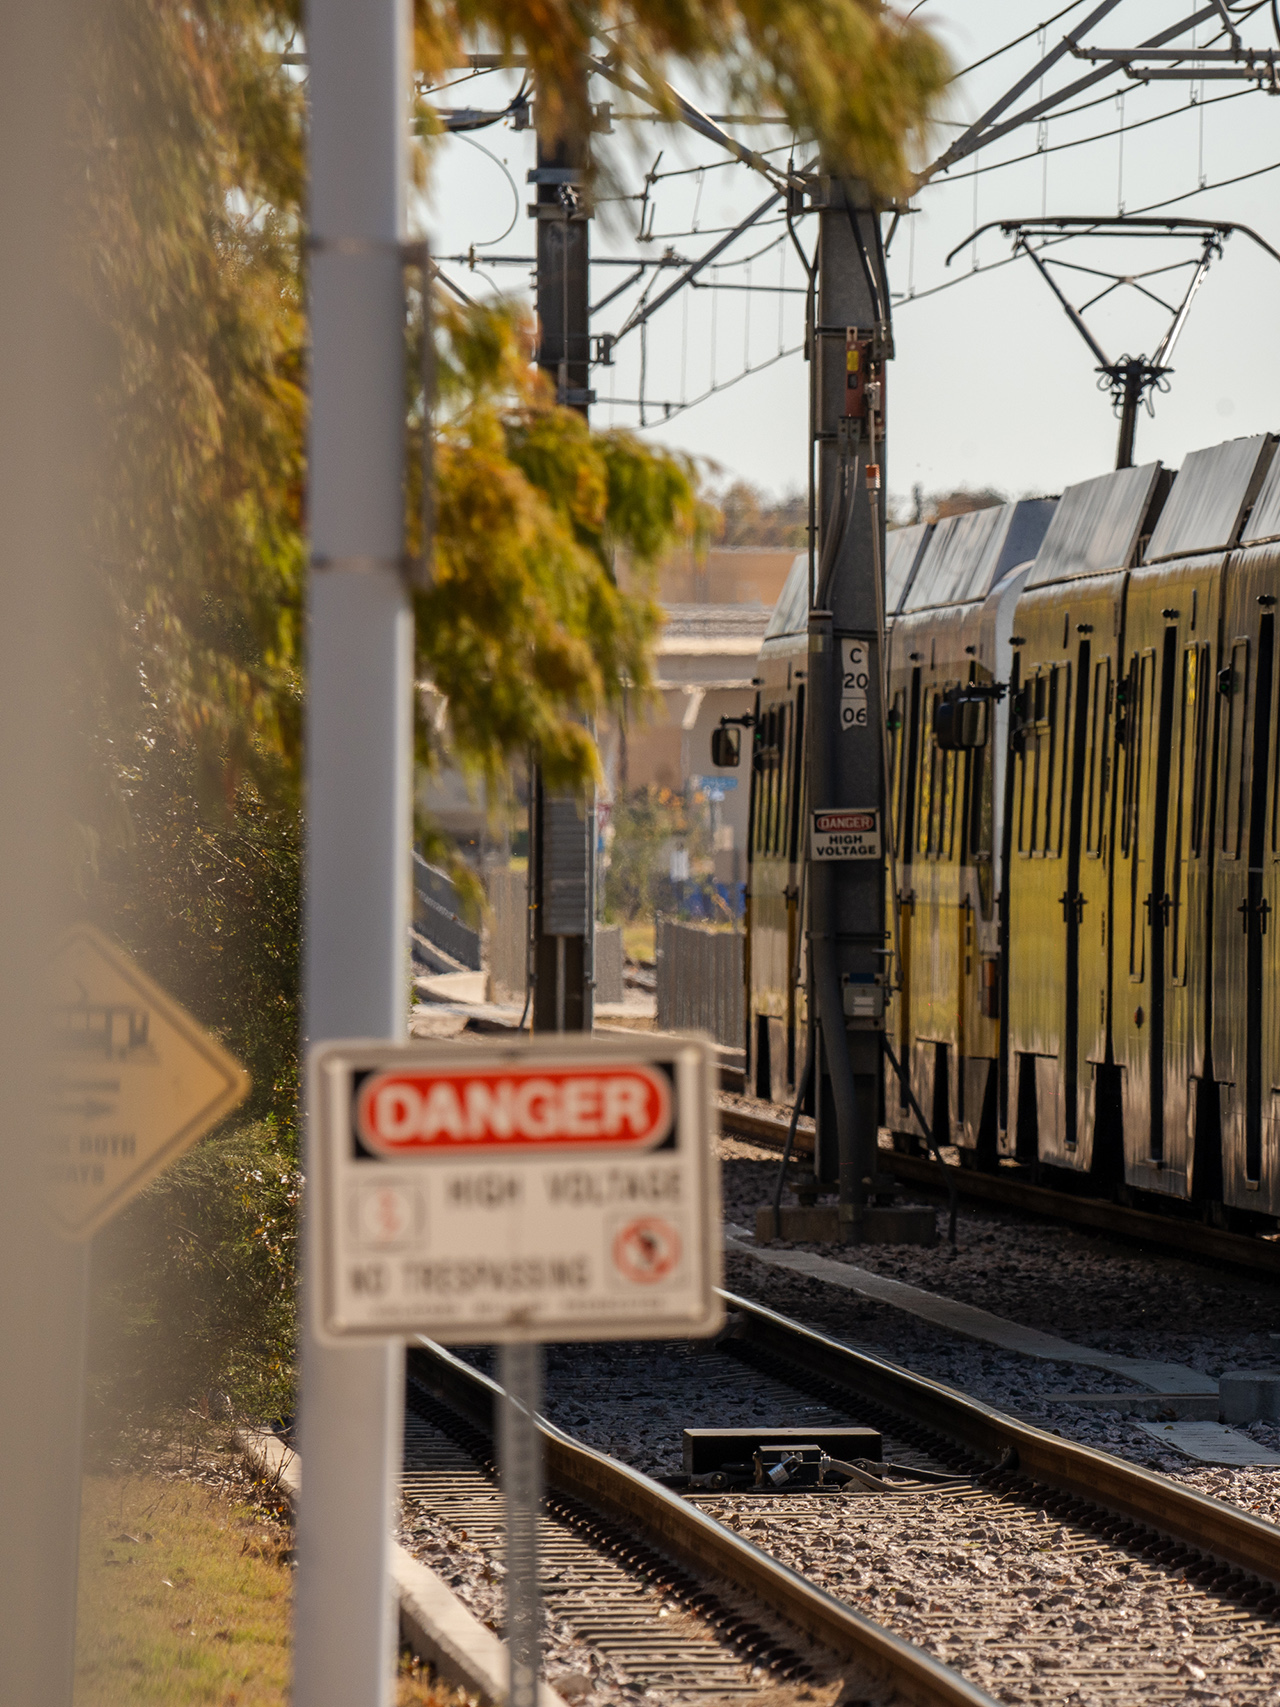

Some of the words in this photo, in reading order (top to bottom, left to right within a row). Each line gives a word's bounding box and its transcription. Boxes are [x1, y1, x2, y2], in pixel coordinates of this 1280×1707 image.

[849, 647, 862, 664] C
[844, 673, 869, 689] 20
[843, 707, 867, 724] 06
[820, 816, 870, 829] DANGER
[829, 835, 863, 845] HIGH
[816, 845, 877, 856] VOLTAGE
[371, 1076, 652, 1143] DANGER
